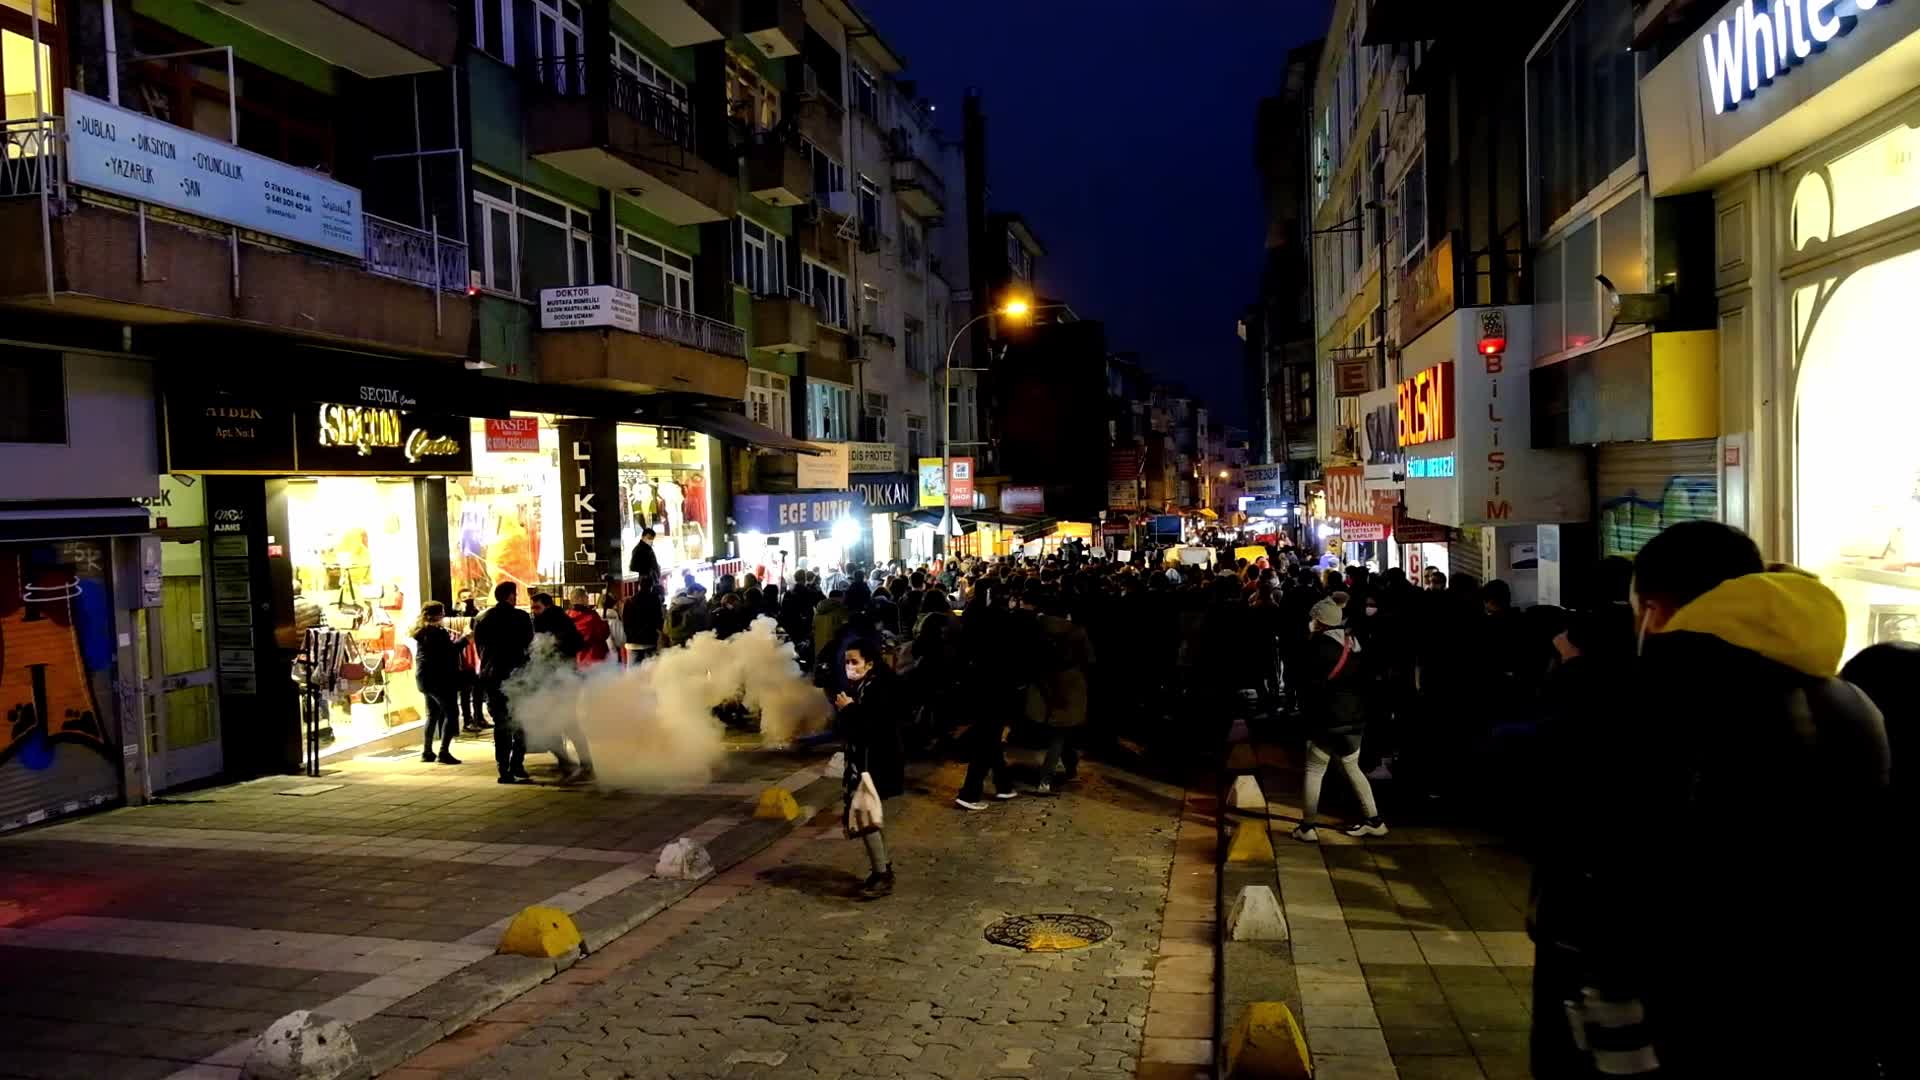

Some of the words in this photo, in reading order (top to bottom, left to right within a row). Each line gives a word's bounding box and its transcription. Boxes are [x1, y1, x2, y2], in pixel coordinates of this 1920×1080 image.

[1703, 0, 1840, 115] White
[82, 115, 116, 142] DUBLAJ
[111, 157, 155, 185] YAZARLIK
[556, 288, 590, 297] DOKTOR
[491, 419, 532, 431] AKSEL
[573, 441, 597, 538] LIKE
[779, 501, 807, 525] EGE
